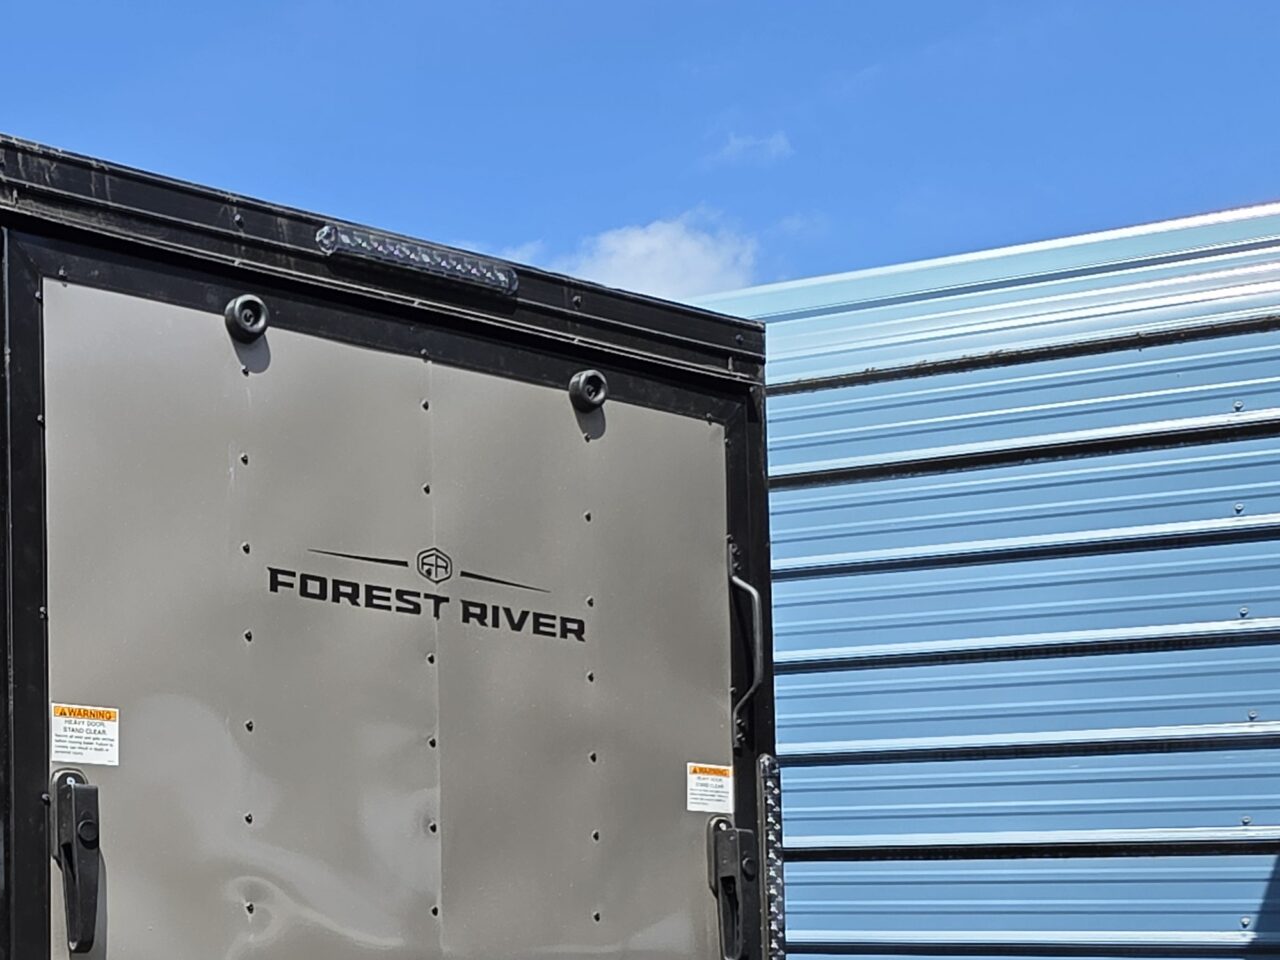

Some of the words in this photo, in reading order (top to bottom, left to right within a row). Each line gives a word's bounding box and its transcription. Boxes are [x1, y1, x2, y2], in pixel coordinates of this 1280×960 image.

[267, 567, 450, 620] FOREST
[460, 600, 586, 642] RIVER
[68, 708, 111, 720] WARNING
